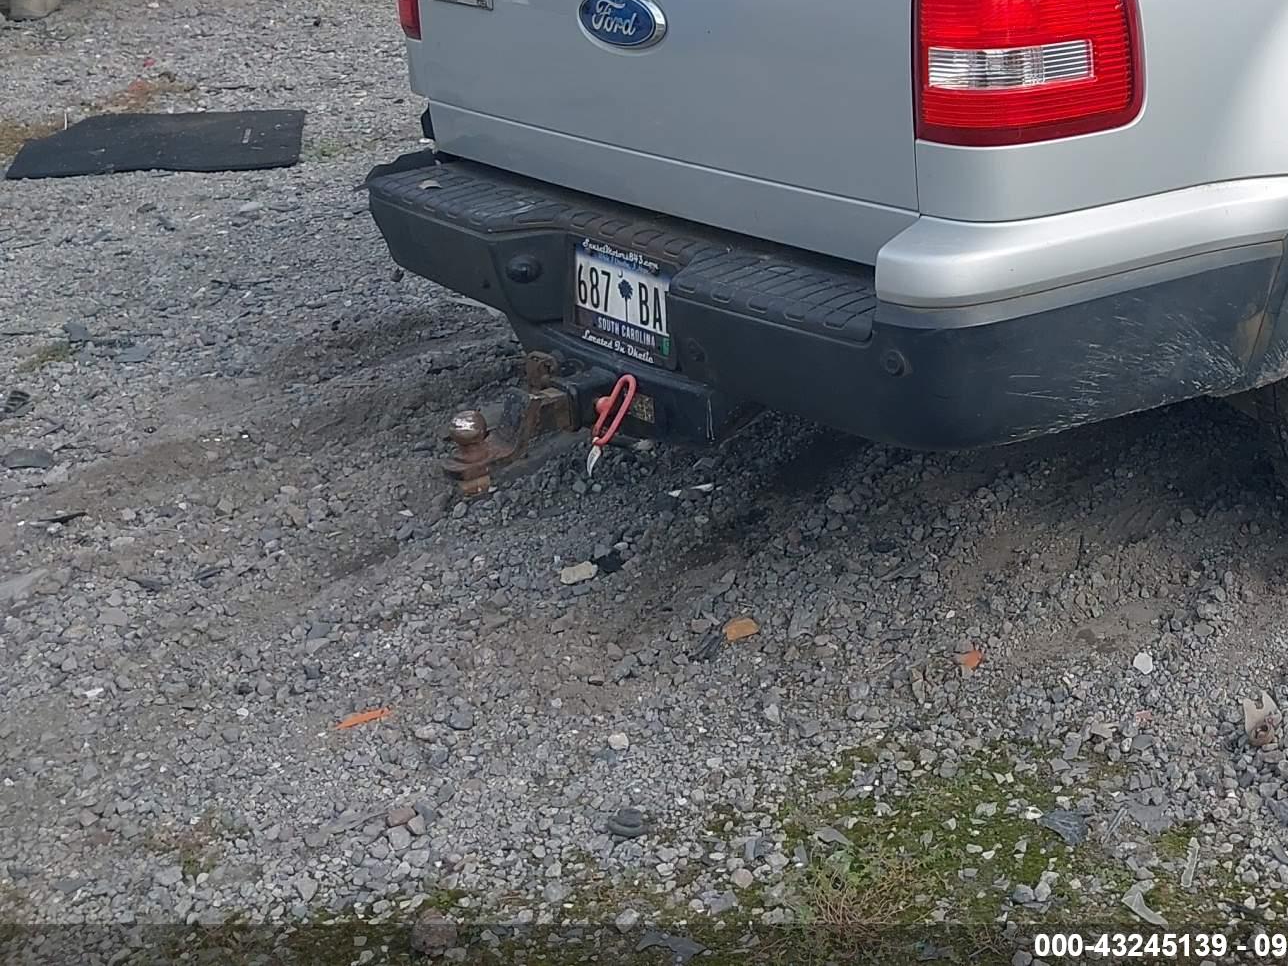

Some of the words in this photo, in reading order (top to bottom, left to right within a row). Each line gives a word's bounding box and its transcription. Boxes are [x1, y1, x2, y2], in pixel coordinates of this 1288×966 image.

[578, 264, 611, 313] 687
[638, 282, 669, 334] BA
[582, 330, 614, 349] Located
[598, 316, 620, 336] SOUTH
[621, 325, 656, 346] CAROLINA
